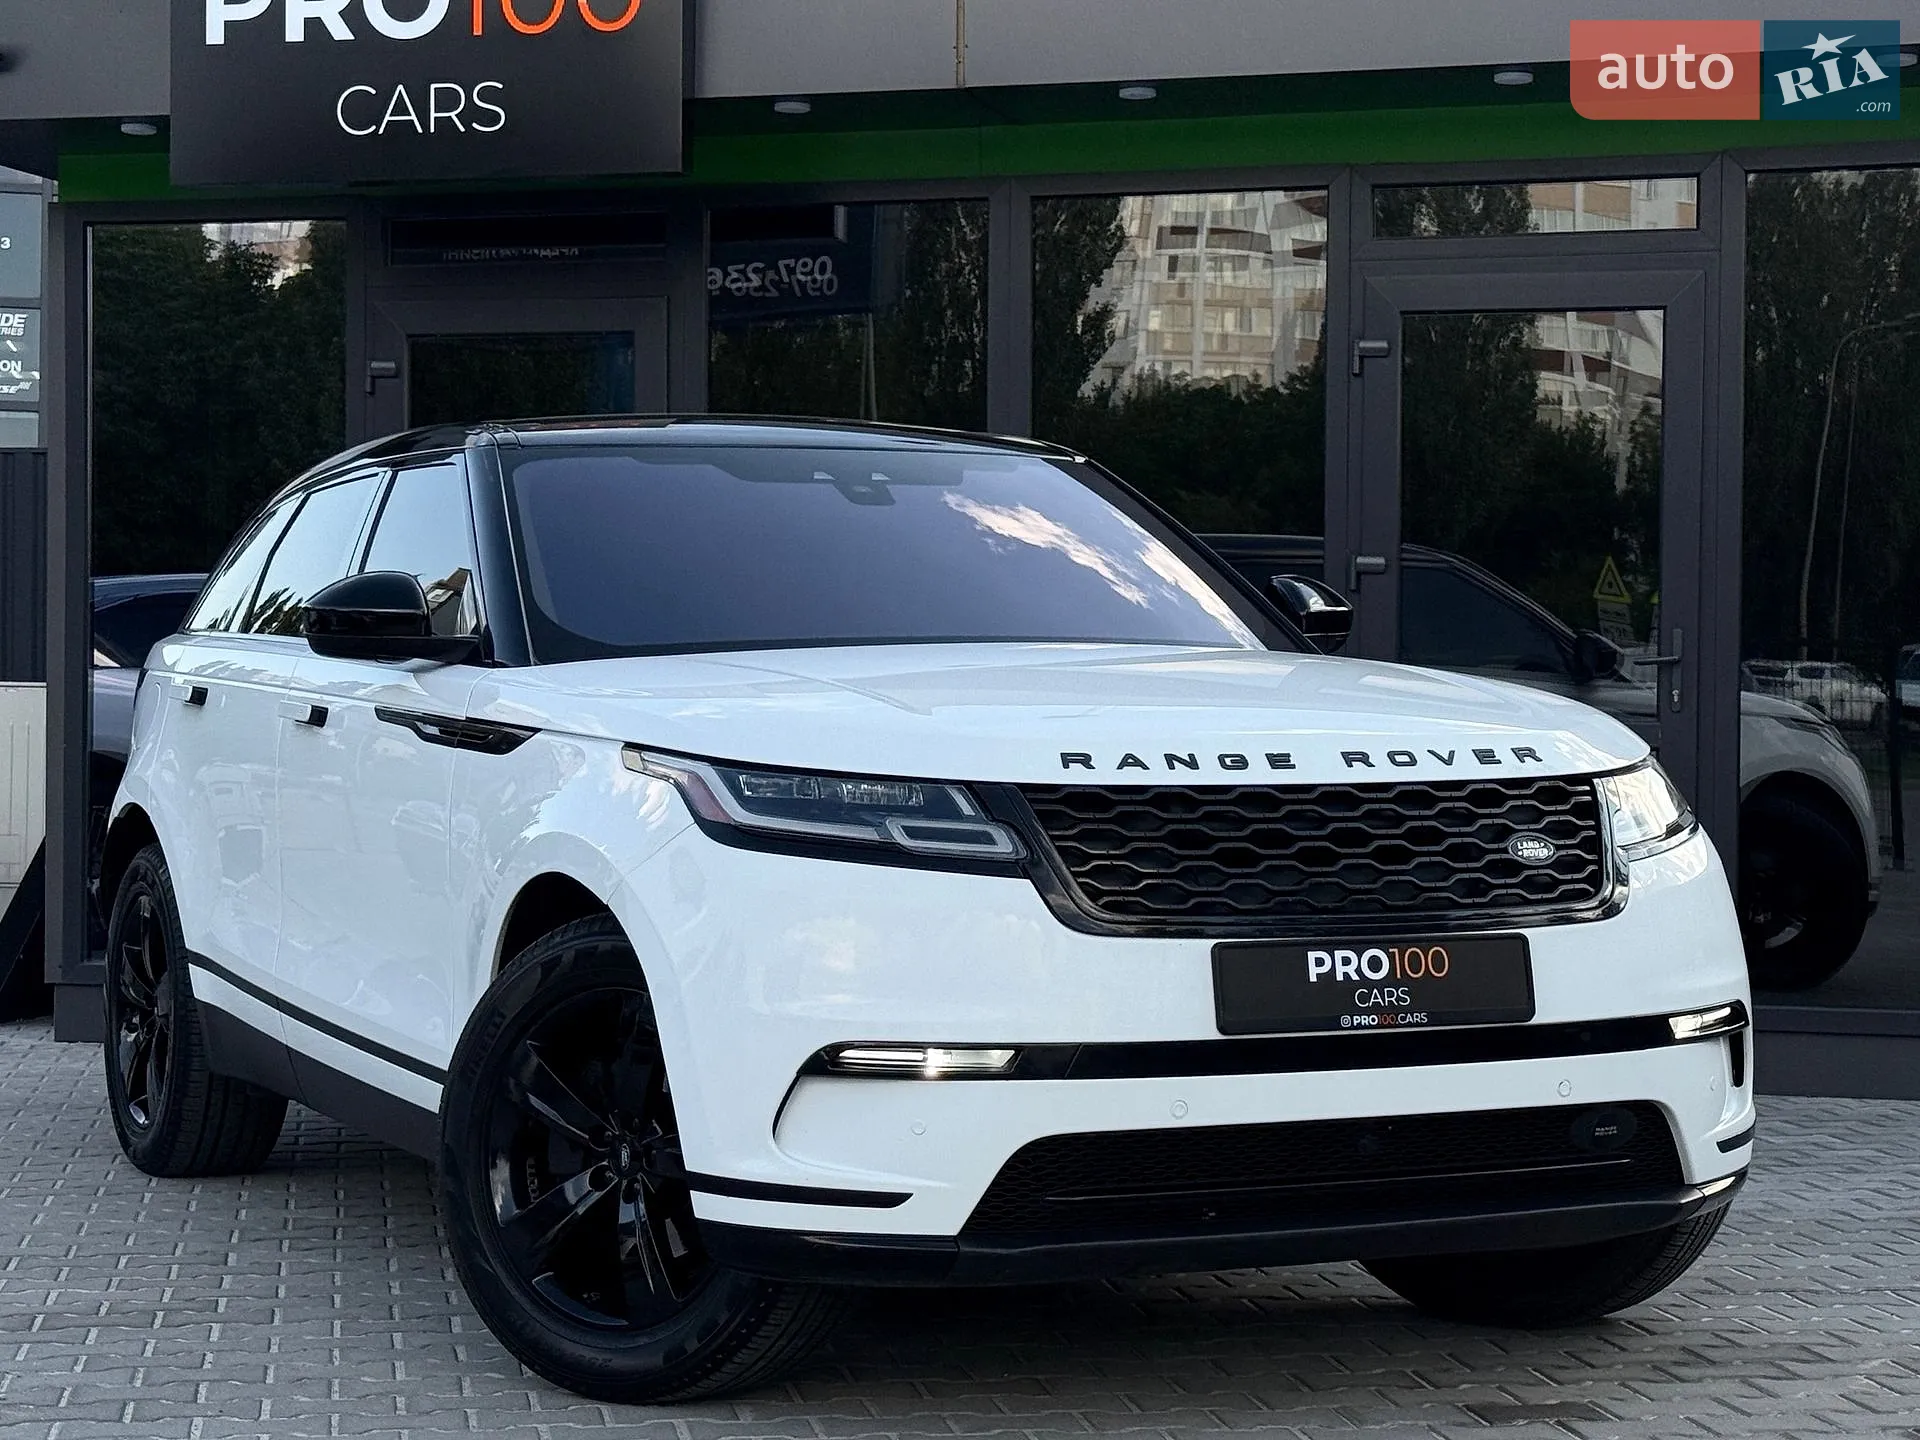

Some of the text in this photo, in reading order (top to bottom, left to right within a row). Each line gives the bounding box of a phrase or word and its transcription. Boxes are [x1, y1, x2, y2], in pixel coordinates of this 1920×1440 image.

[336, 81, 507, 136] CARS
[1060, 747, 1543, 770] RANGE ROVER
[1517, 841, 1540, 849] LAND
[1523, 848, 1549, 857] ROVER
[1307, 947, 1449, 982] PRO100
[1355, 987, 1411, 1007] CARS
[1353, 1012, 1428, 1027] PRO100.CARS
